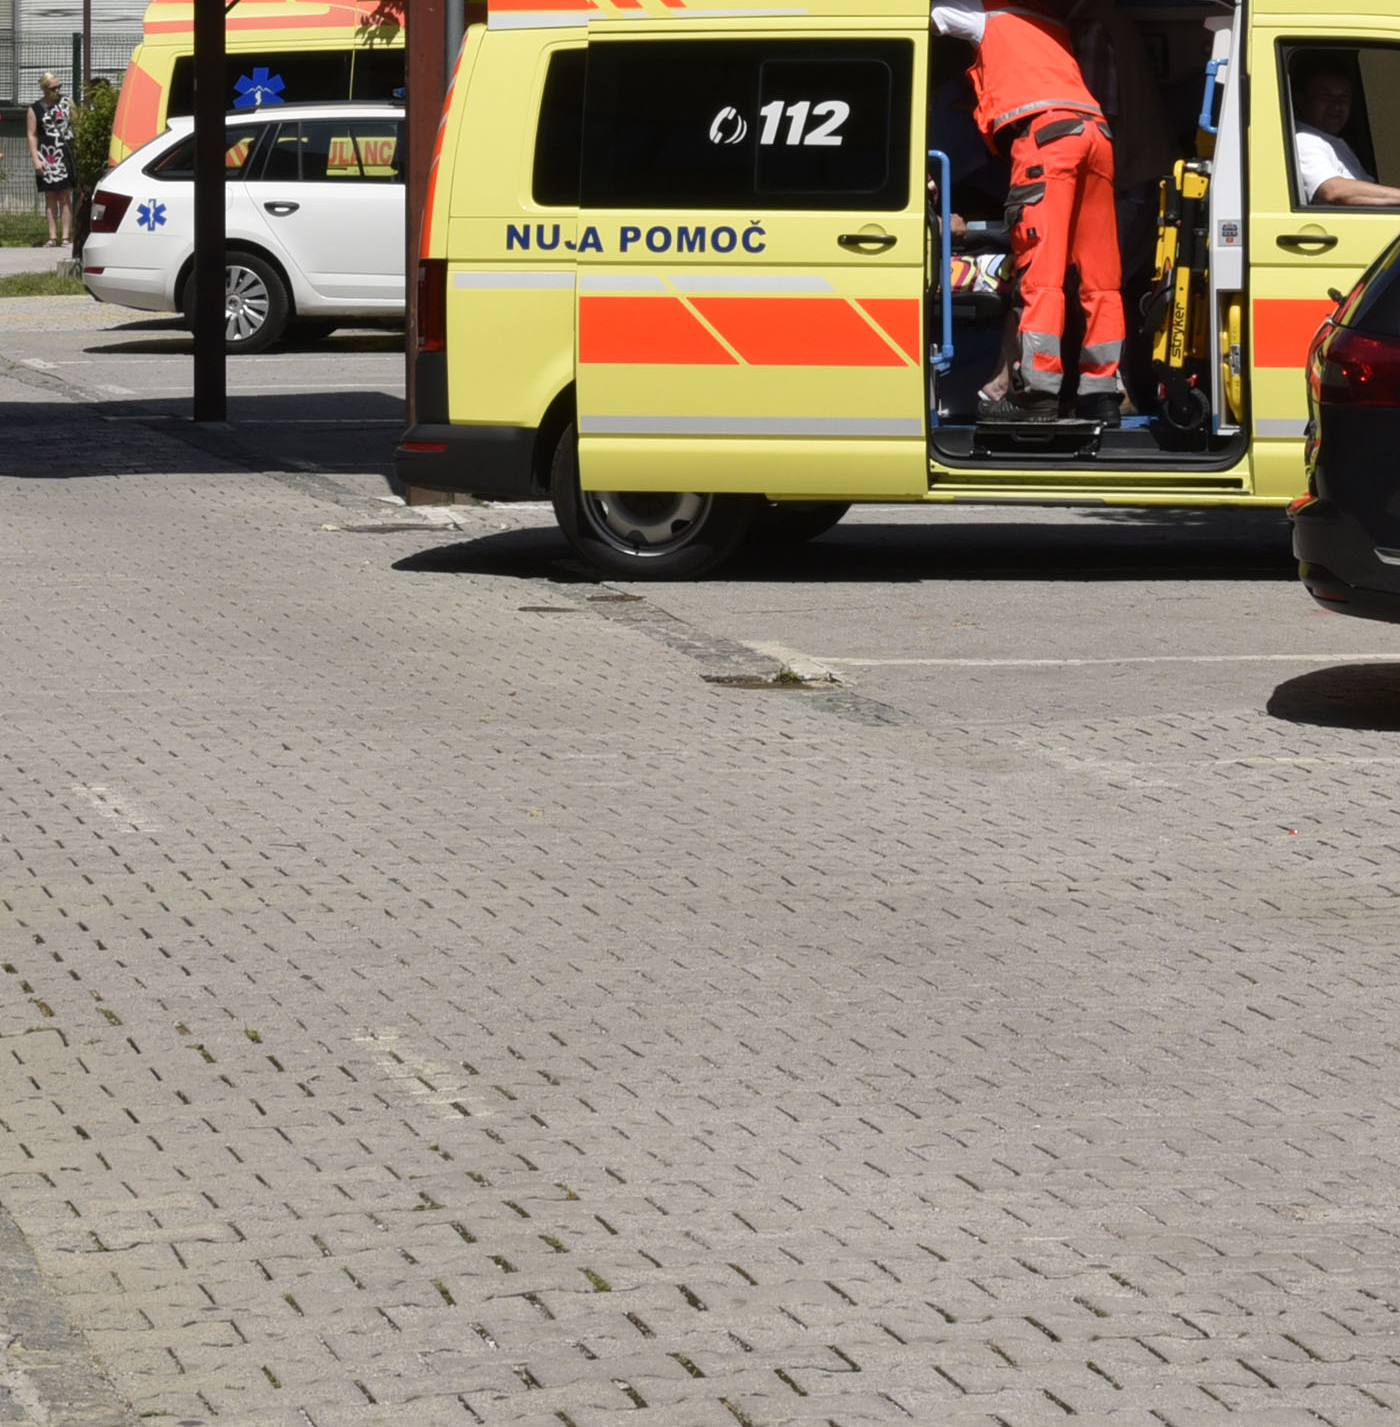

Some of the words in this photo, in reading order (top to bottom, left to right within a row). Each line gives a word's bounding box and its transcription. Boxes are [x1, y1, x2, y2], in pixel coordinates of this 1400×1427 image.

[759, 99, 851, 147] 112
[619, 219, 767, 254] POMOČ
[1171, 301, 1186, 360] stryker
